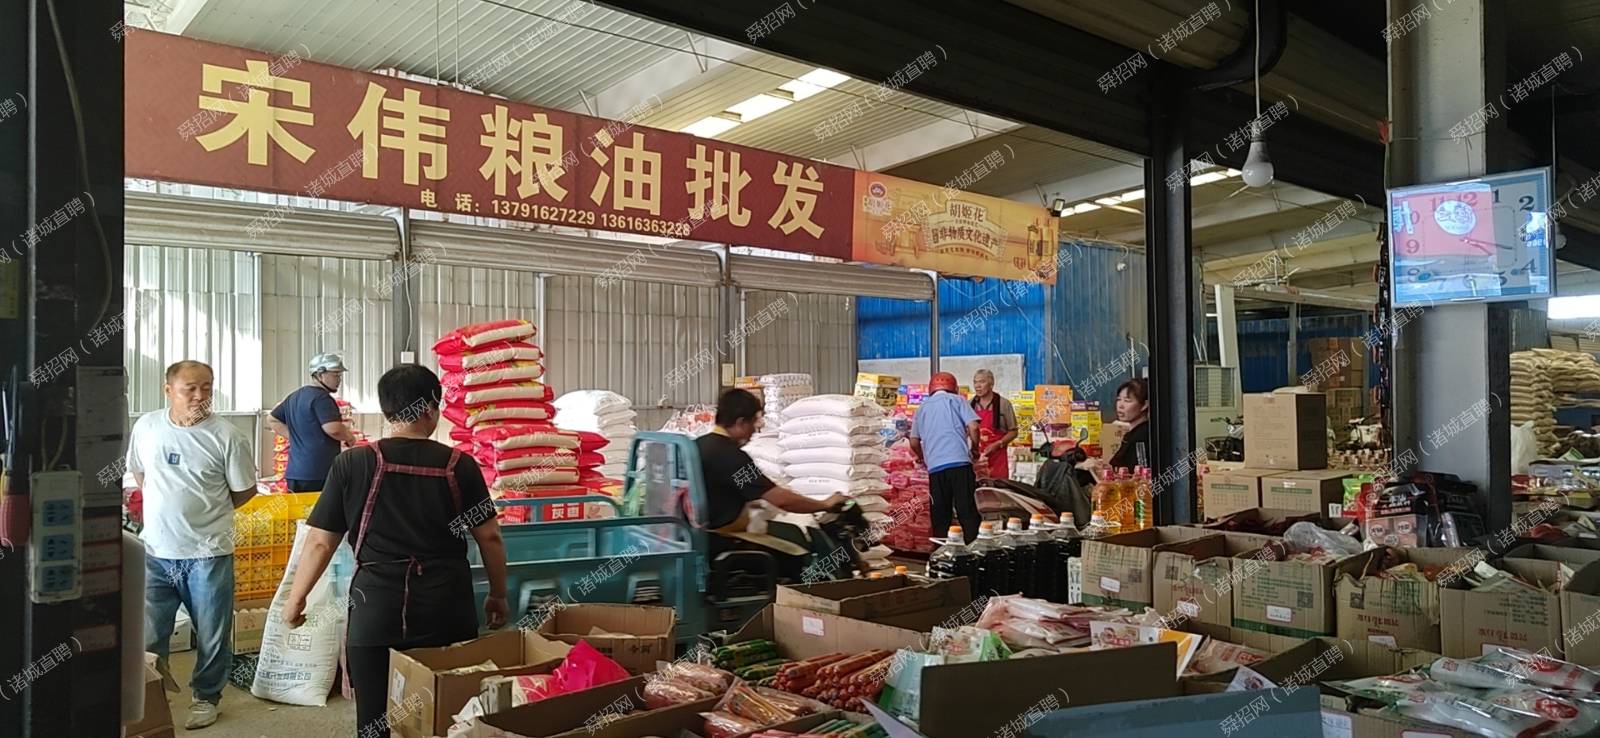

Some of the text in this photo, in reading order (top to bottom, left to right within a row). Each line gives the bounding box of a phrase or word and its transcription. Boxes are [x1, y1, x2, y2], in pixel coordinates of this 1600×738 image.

[196, 60, 825, 239] 宋伟粮油批发
[1518, 195, 1535, 211] 2
[491, 200, 596, 225] 13791627229
[601, 213, 691, 236] 13616363228
[1406, 239, 1419, 254] 9
